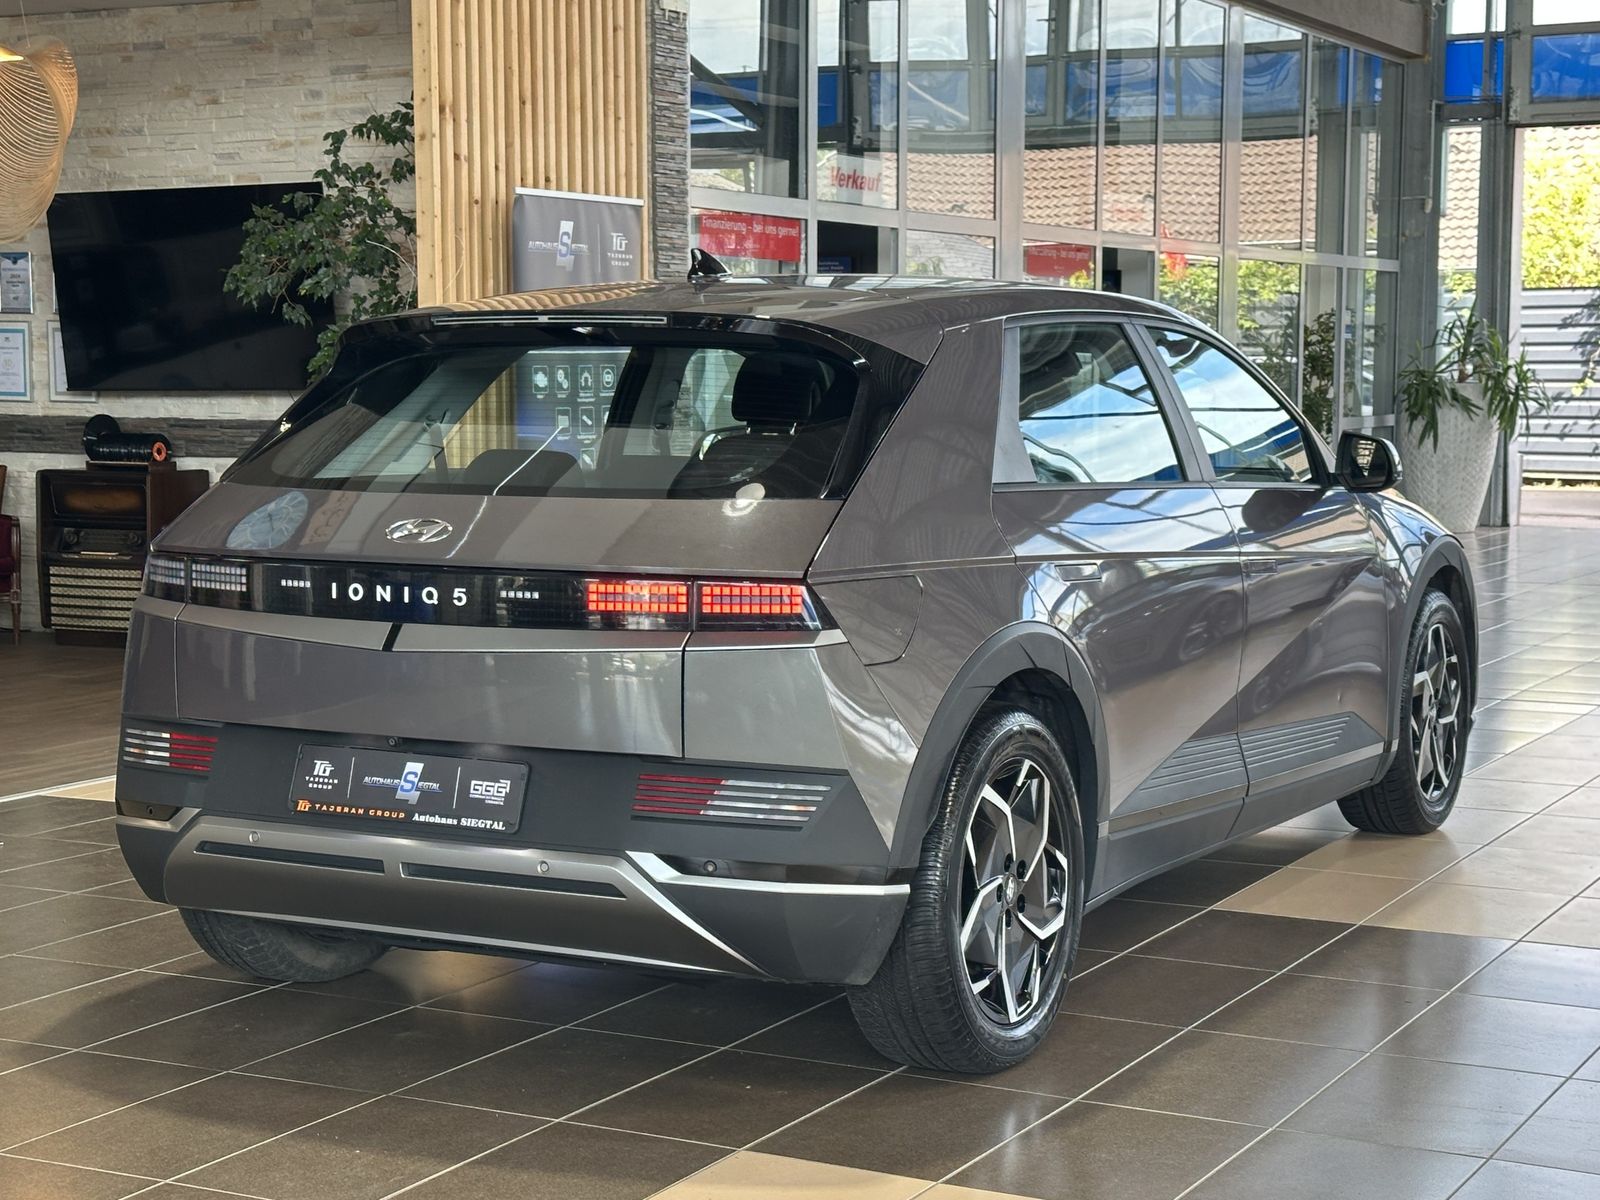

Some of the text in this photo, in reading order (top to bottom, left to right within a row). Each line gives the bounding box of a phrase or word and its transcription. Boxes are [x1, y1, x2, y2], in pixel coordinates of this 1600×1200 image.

[831, 166, 881, 192] Verkauf
[702, 215, 747, 235] Finanzierung
[753, 221, 764, 234] bei
[765, 225, 777, 235] uns
[778, 226, 799, 239] gerne!
[331, 582, 467, 607] IONIQ 5
[363, 776, 401, 786] AUTOHAUS
[470, 780, 508, 797] GGG
[368, 809, 406, 819] GROUP
[412, 813, 506, 831] Autohaus SIEGTAL
